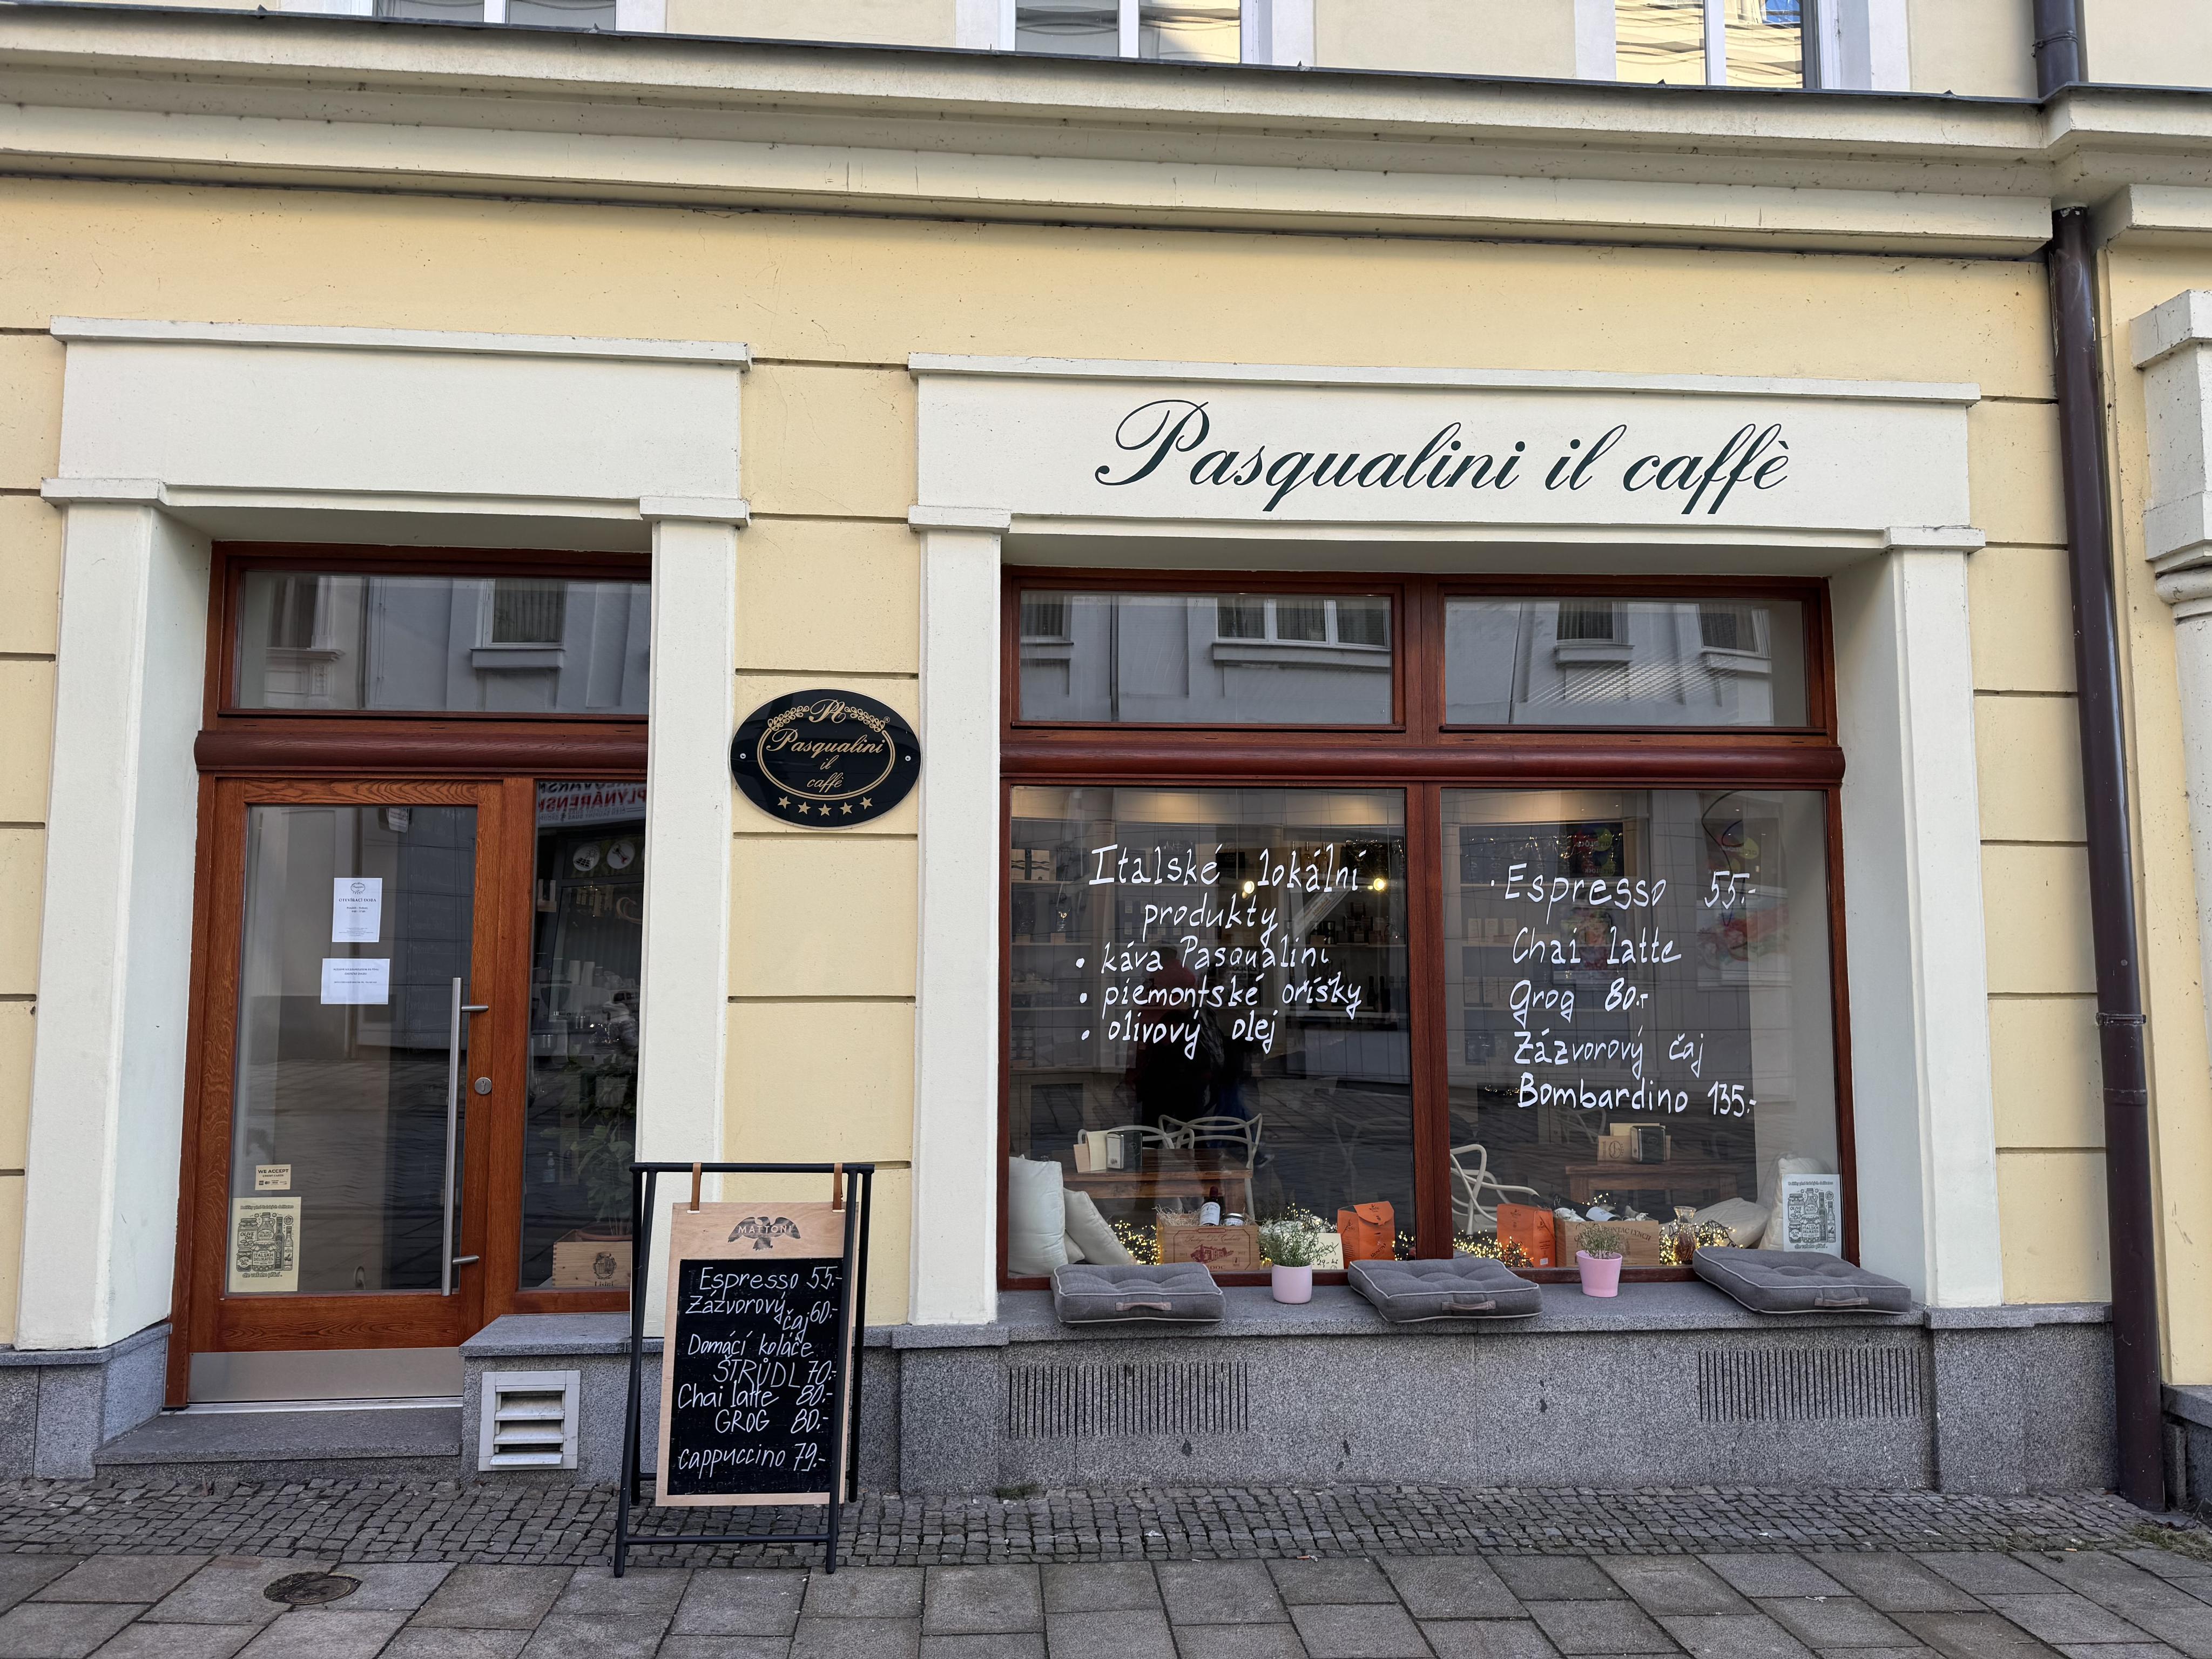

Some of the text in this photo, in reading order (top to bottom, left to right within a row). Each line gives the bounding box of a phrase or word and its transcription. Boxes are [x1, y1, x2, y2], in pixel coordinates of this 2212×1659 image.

[1095, 399, 1793, 515] Pasqualini il caffè
[766, 729, 885, 758] Pasqualini
[820, 755, 839, 770] il
[807, 772, 844, 792] caffè
[1089, 844, 1367, 892] Italské lokální
[1505, 863, 1667, 924] Espresso
[1142, 893, 1278, 945] produkty
[1101, 941, 1163, 974] káva
[1513, 926, 1682, 965] Chai latte
[1102, 972, 1363, 1020] piemontské oříšky
[1109, 1006, 1278, 1060] olivový olej
[1514, 1025, 1703, 1080] Zázvorový čaj
[1518, 1071, 1688, 1114] Bombardino
[738, 1225, 792, 1233] MATTONI
[1631, 1229, 1651, 1242] LYNCH
[699, 1267, 798, 1299] Espresso
[685, 1291, 786, 1324] Zázvorový
[783, 1309, 809, 1343] čaj
[688, 1331, 814, 1357] Domácí koláče
[713, 1354, 800, 1388] ŠTRŮDL
[678, 1383, 723, 1408] Chai
[730, 1380, 779, 1407] latte
[716, 1409, 770, 1433] GROG
[678, 1444, 785, 1479] cappuccino
